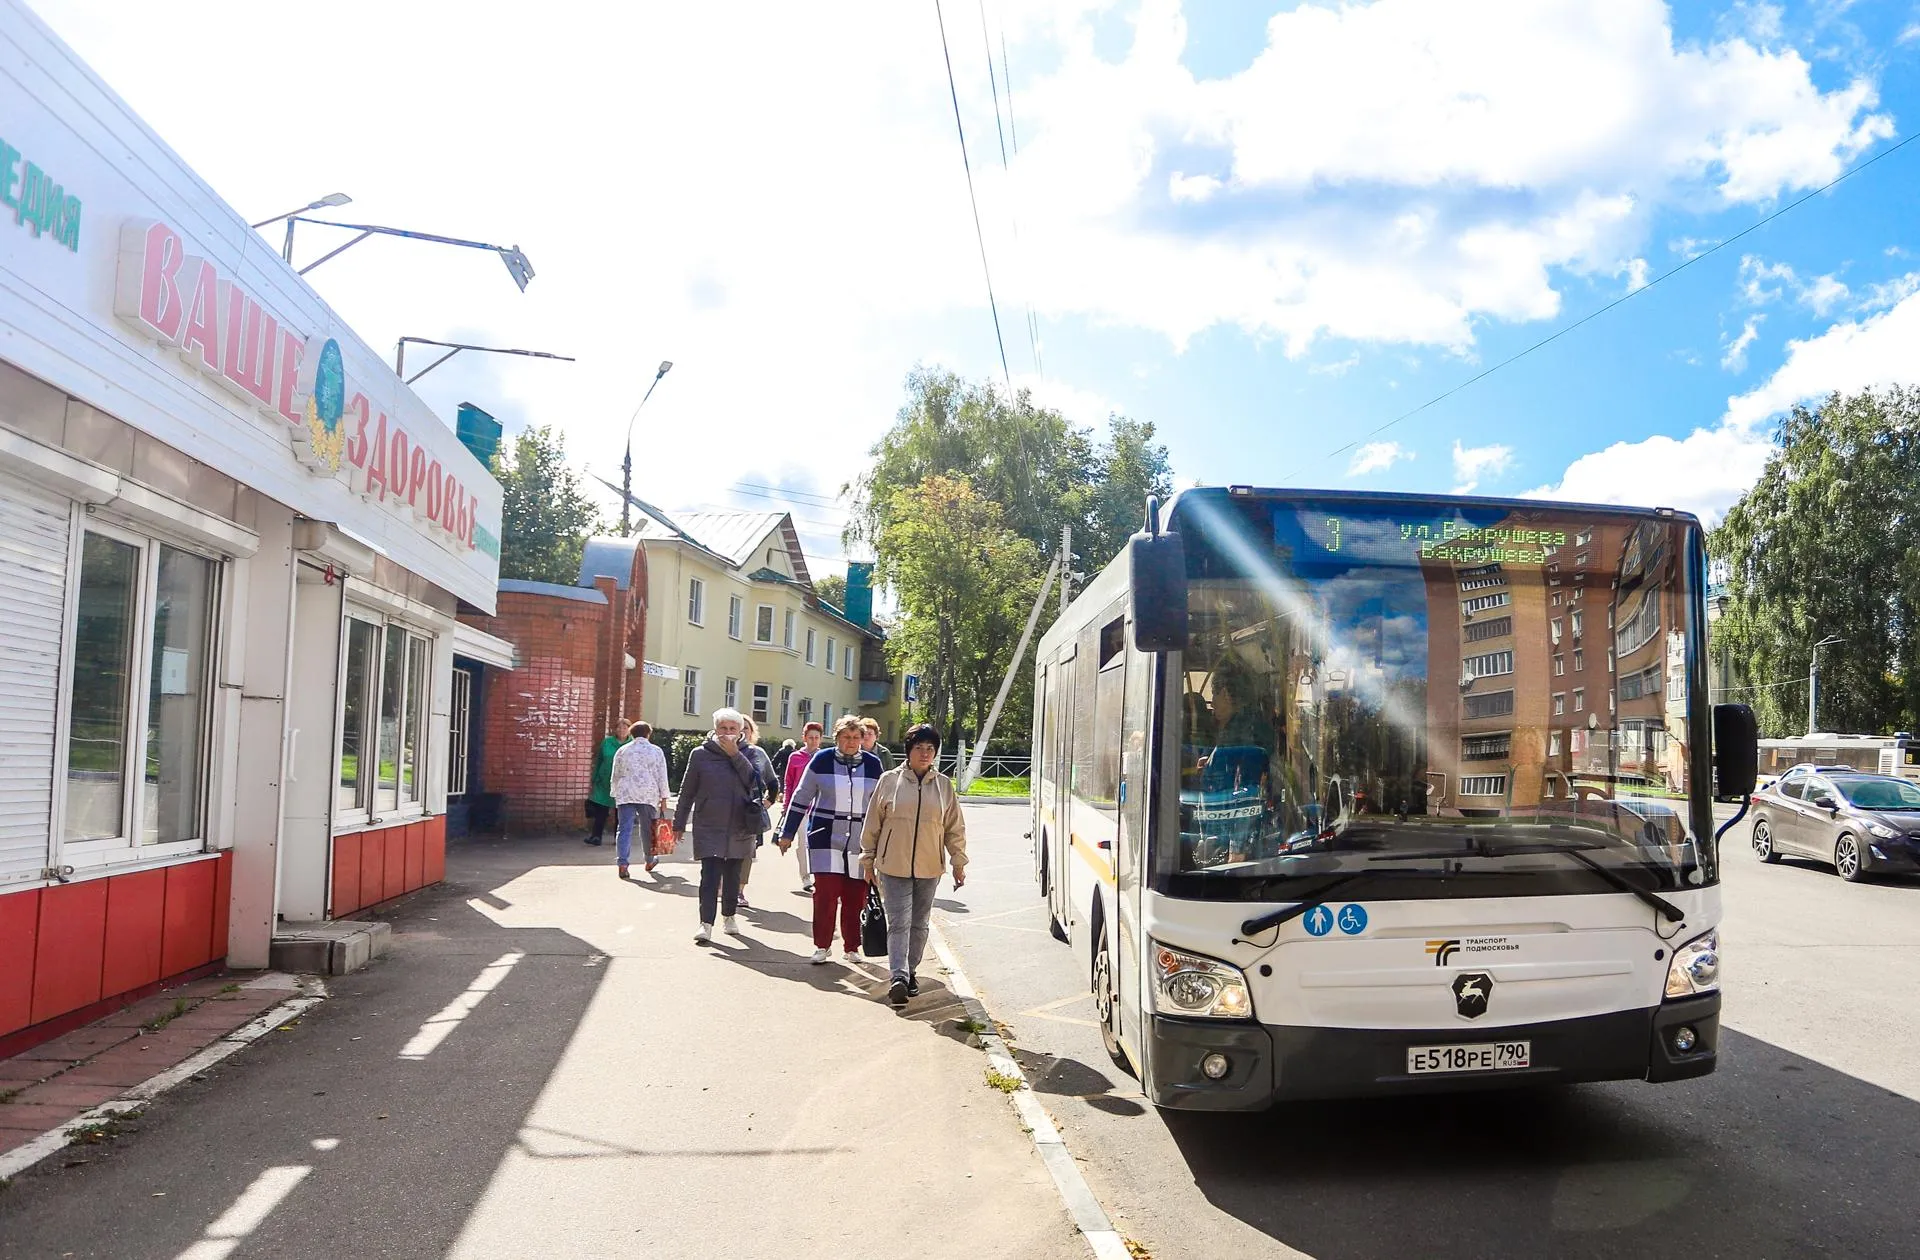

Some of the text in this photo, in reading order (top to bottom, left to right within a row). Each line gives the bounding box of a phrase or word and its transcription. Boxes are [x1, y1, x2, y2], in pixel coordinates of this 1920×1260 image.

[0, 137, 82, 253] ЕДИЯ
[139, 222, 478, 551] ВАШЕ ЗДОРОВЬЕ
[1326, 518, 1341, 552] 3
[1420, 540, 1546, 564] Вахрушева
[1465, 937, 1508, 945] ТРАНСПОРТ
[1465, 944, 1520, 952] ПОДМОСКОВЬЯ
[1414, 1043, 1525, 1070] Е518РЕ 790
